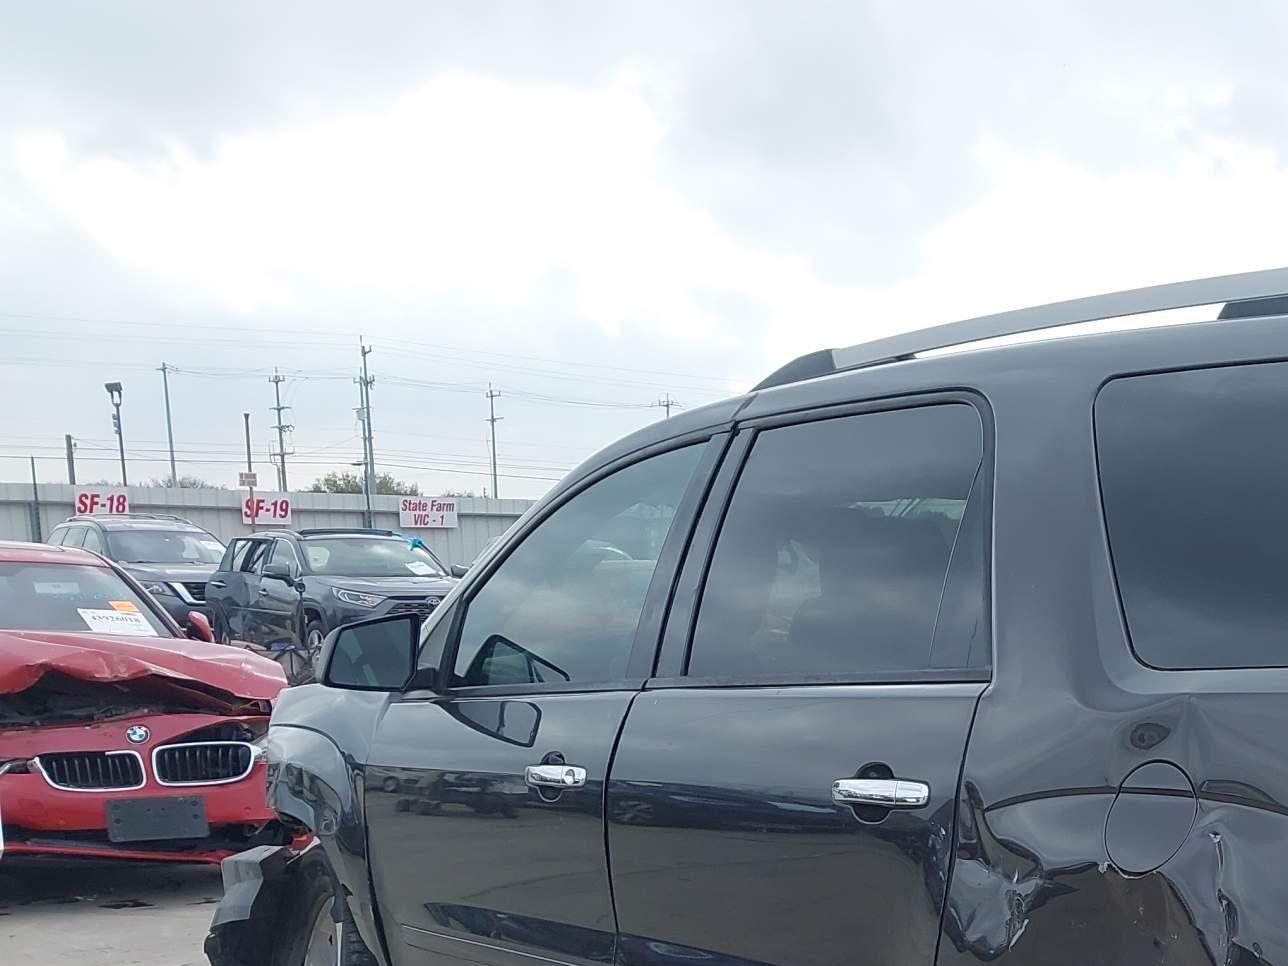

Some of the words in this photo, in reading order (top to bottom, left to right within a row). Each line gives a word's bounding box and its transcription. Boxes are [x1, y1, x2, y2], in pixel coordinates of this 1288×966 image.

[76, 493, 127, 514] SF-18
[243, 499, 290, 519] SF-19
[401, 499, 428, 512] State
[430, 500, 455, 513] Farm
[414, 514, 430, 526] VIC
[440, 514, 445, 526] 1
